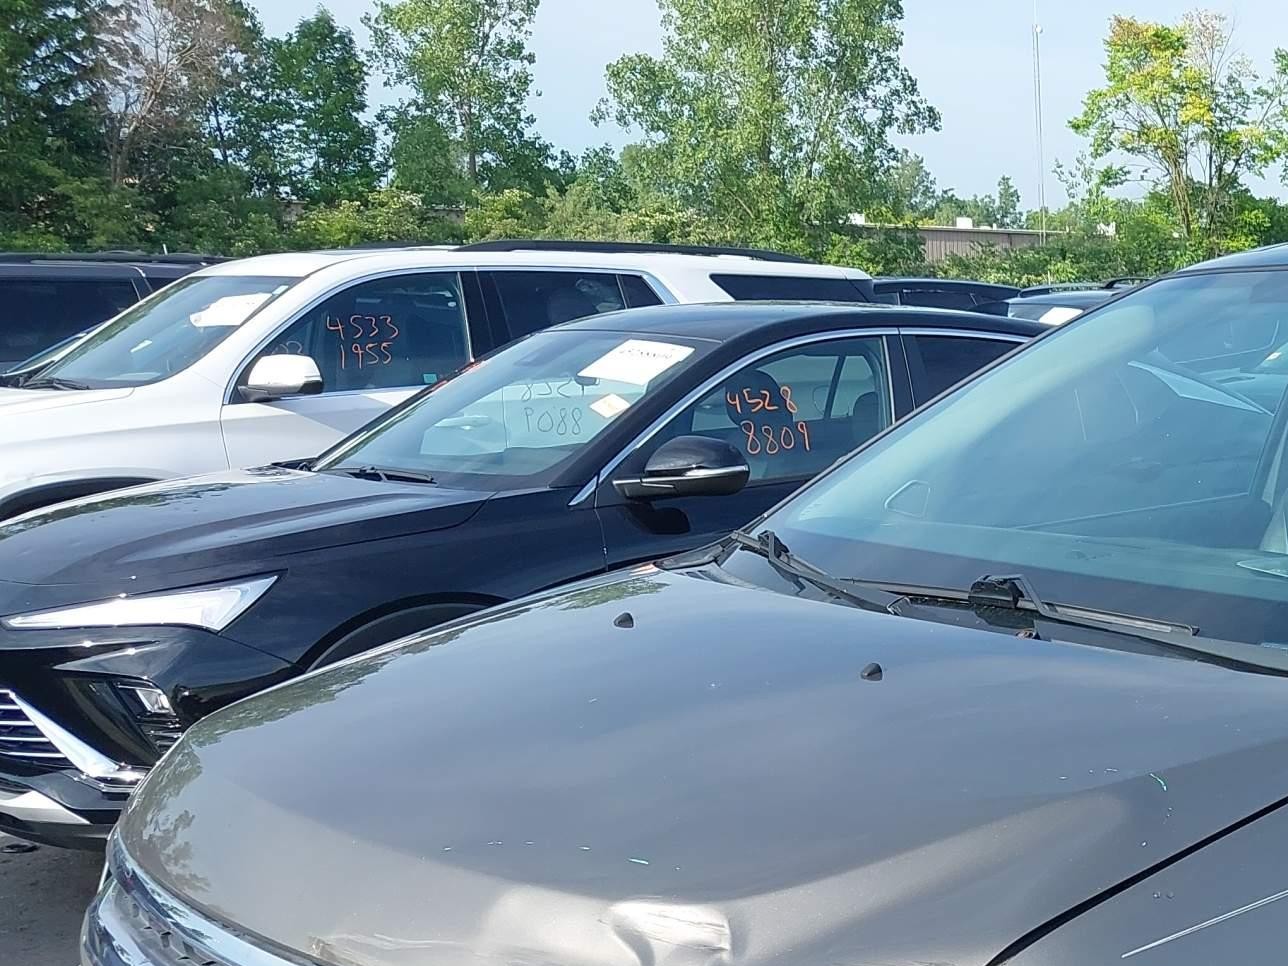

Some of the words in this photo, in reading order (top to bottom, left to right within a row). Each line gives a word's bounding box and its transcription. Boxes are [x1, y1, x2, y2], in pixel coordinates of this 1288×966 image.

[326, 315, 399, 340] 4533
[340, 342, 393, 369] 1955
[726, 386, 797, 414] 4528
[740, 420, 809, 454] 8809
